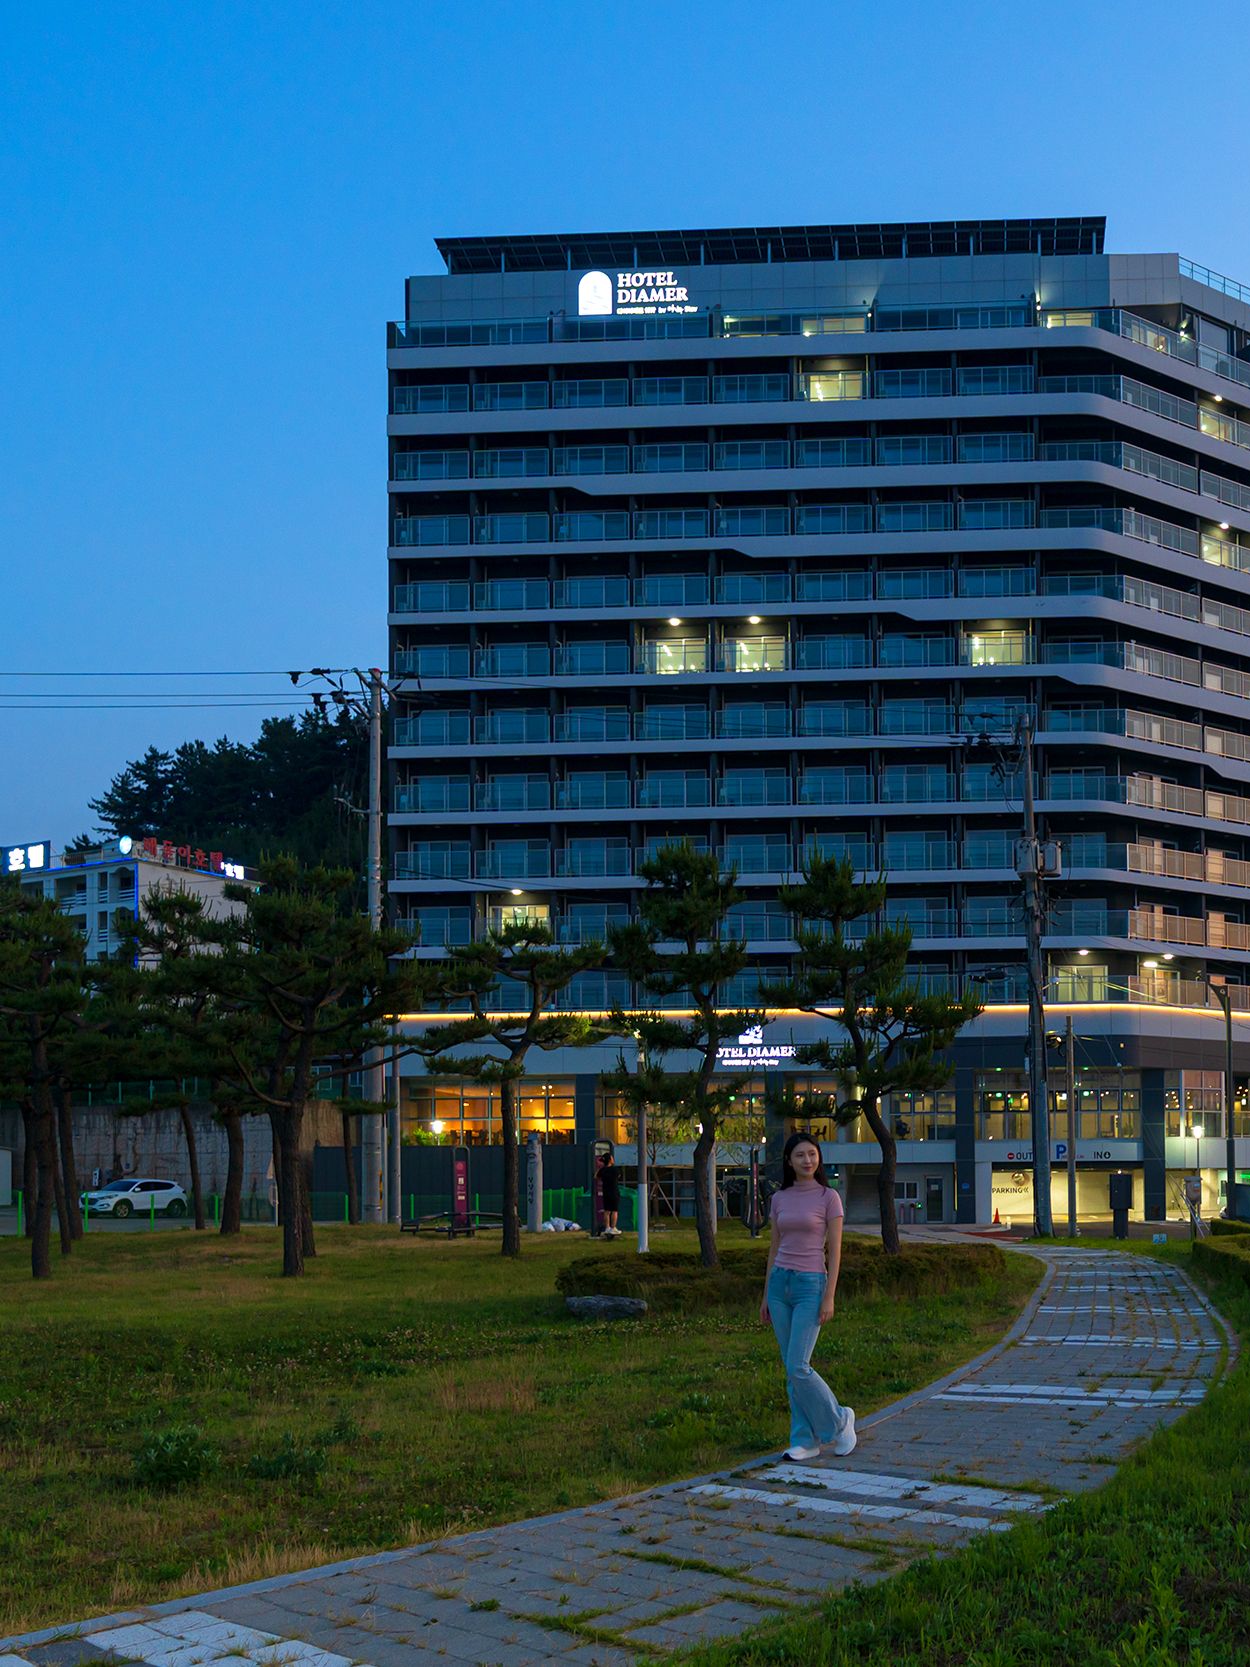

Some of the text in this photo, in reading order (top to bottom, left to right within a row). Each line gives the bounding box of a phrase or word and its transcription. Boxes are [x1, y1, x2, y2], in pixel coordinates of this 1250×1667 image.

[617, 272, 677, 287] HOTEL
[617, 288, 688, 303] DIAMER
[715, 1046, 797, 1058] OTEL DIAMER
[1016, 1151, 1033, 1160] OUT
[1055, 1144, 1067, 1160] P
[1093, 1151, 1103, 1160] IN
